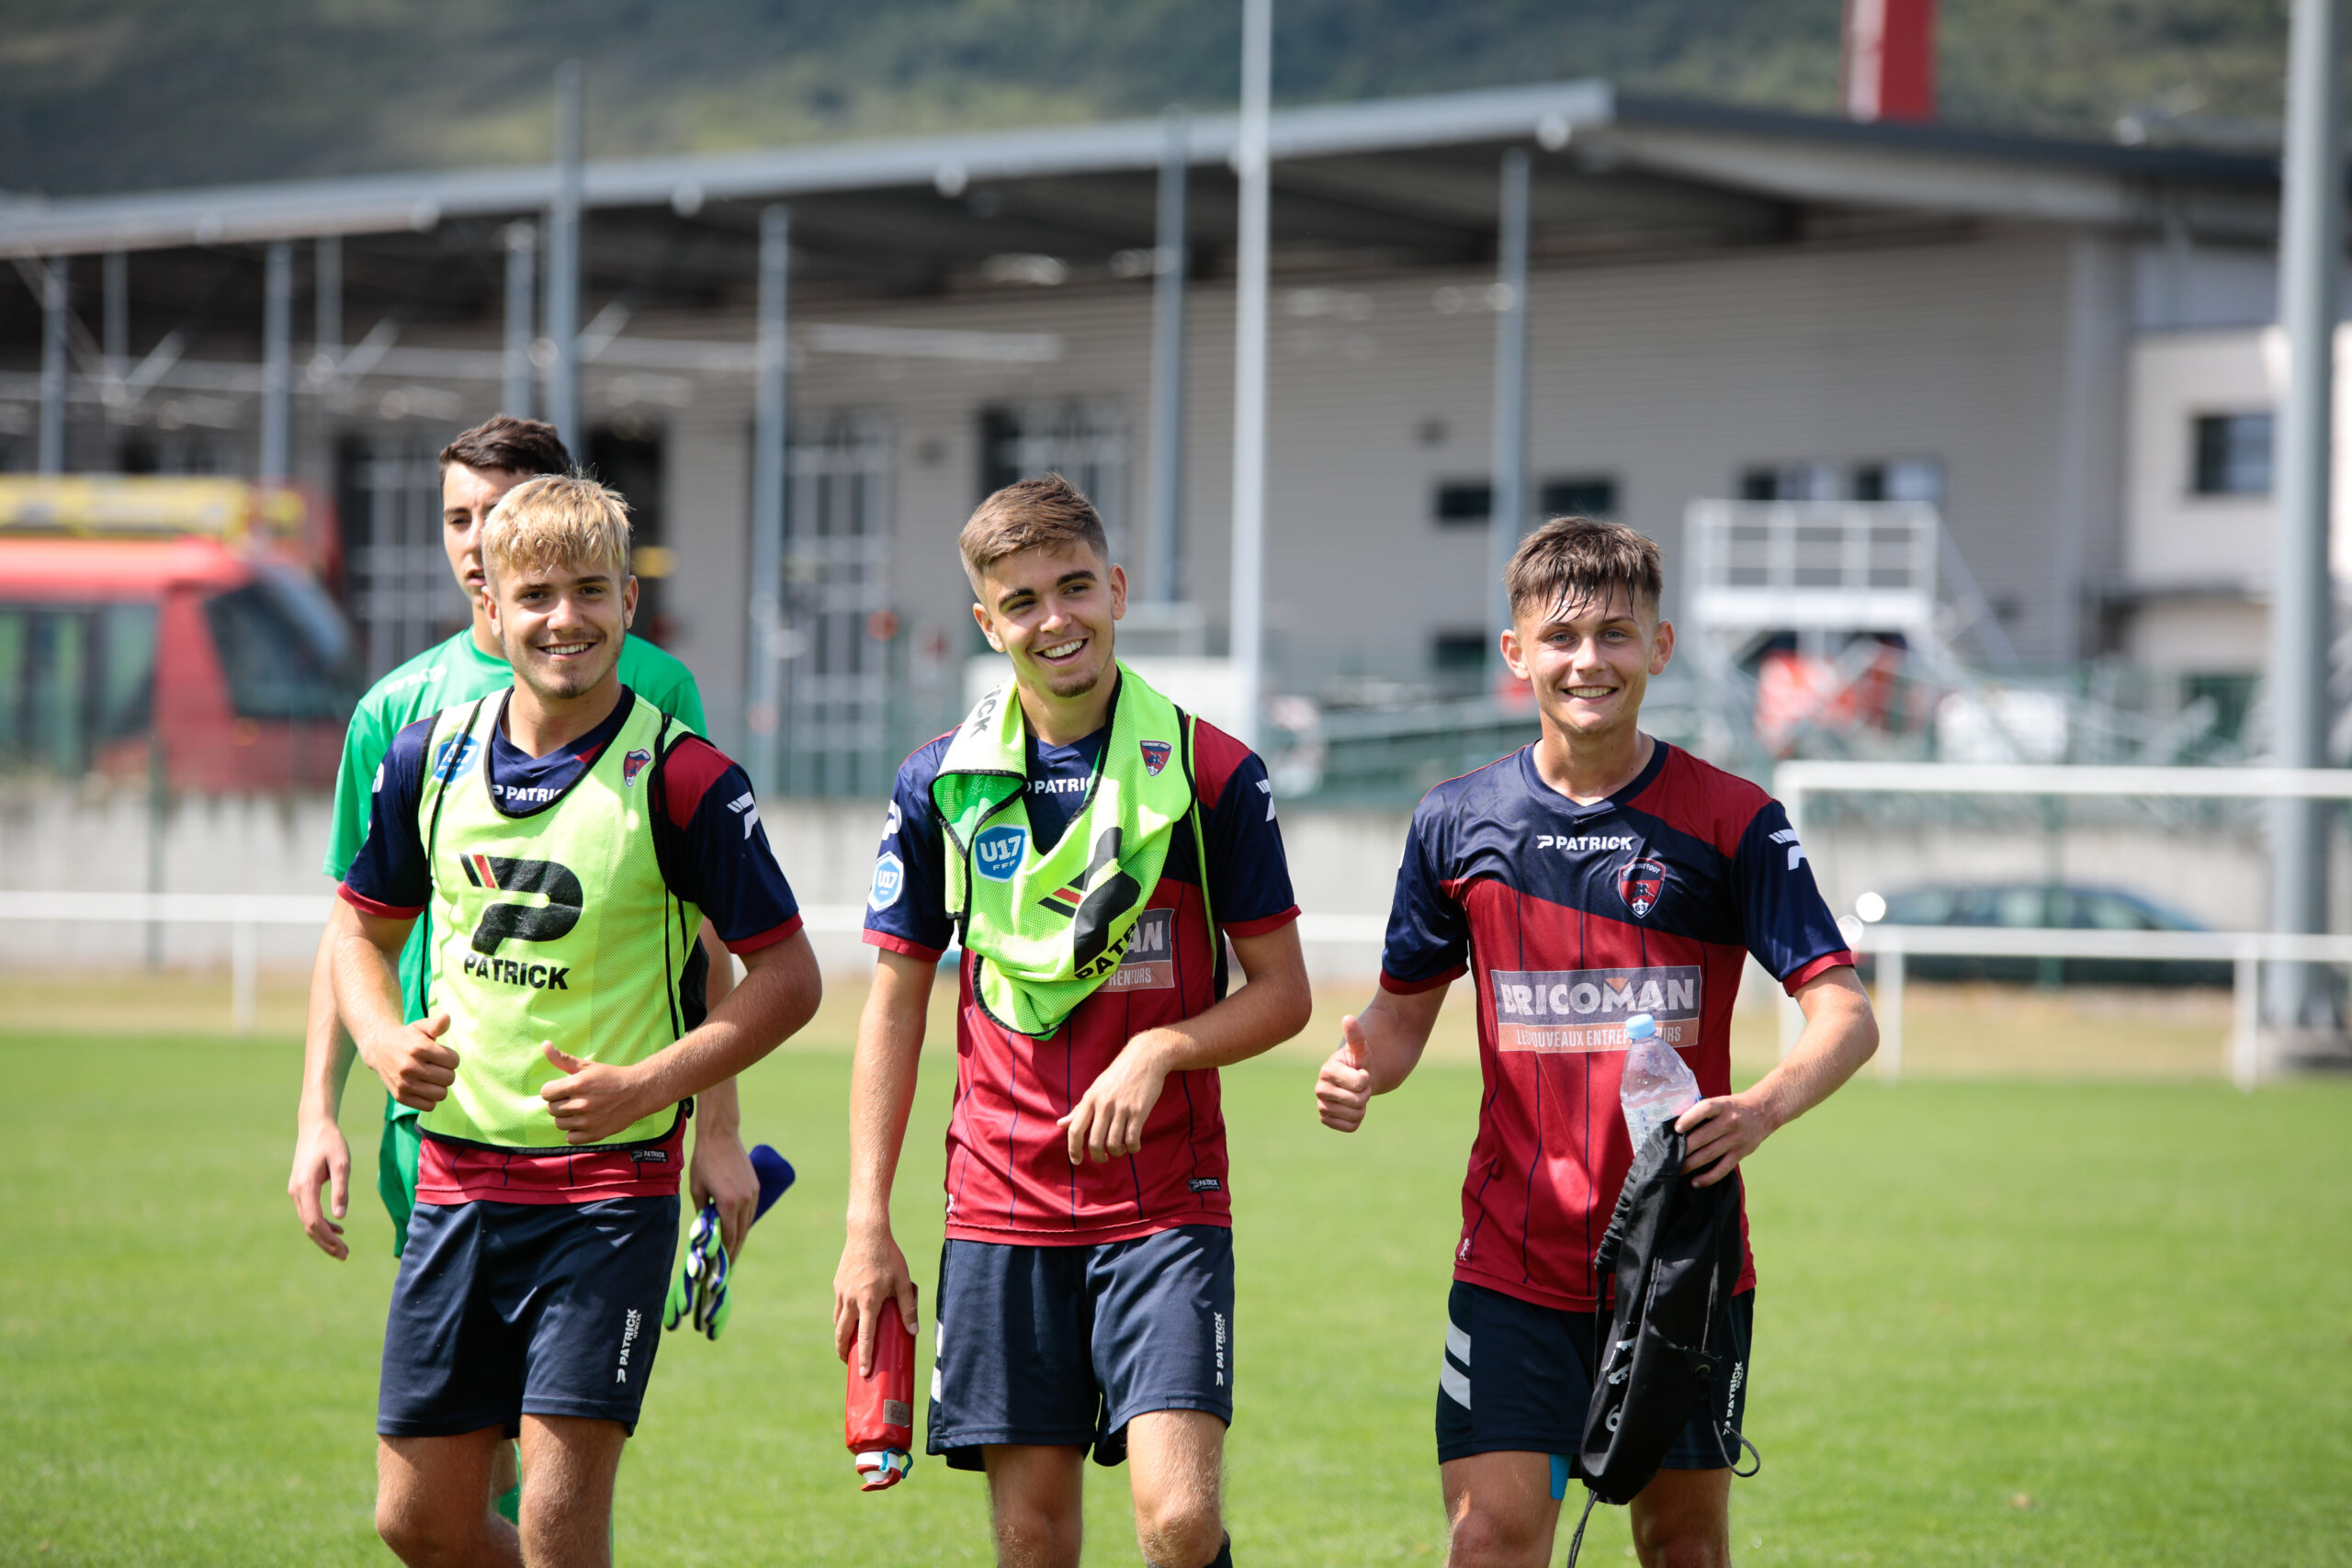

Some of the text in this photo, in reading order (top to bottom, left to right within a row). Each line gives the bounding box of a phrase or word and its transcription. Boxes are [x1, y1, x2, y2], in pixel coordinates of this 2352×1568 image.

[505, 785, 563, 802] PATRI
[978, 834, 1023, 863] U17
[1555, 835, 1634, 851] PATRICK
[877, 870, 899, 889] U17
[1635, 904, 1646, 912] 63
[464, 953, 571, 990] PATRICK
[1500, 977, 1694, 1016] BRICOMAN
[619, 1308, 638, 1366] PATRICK
[1214, 1311, 1225, 1370] PATRICK
[1726, 1360, 1743, 1418] PATRICK
